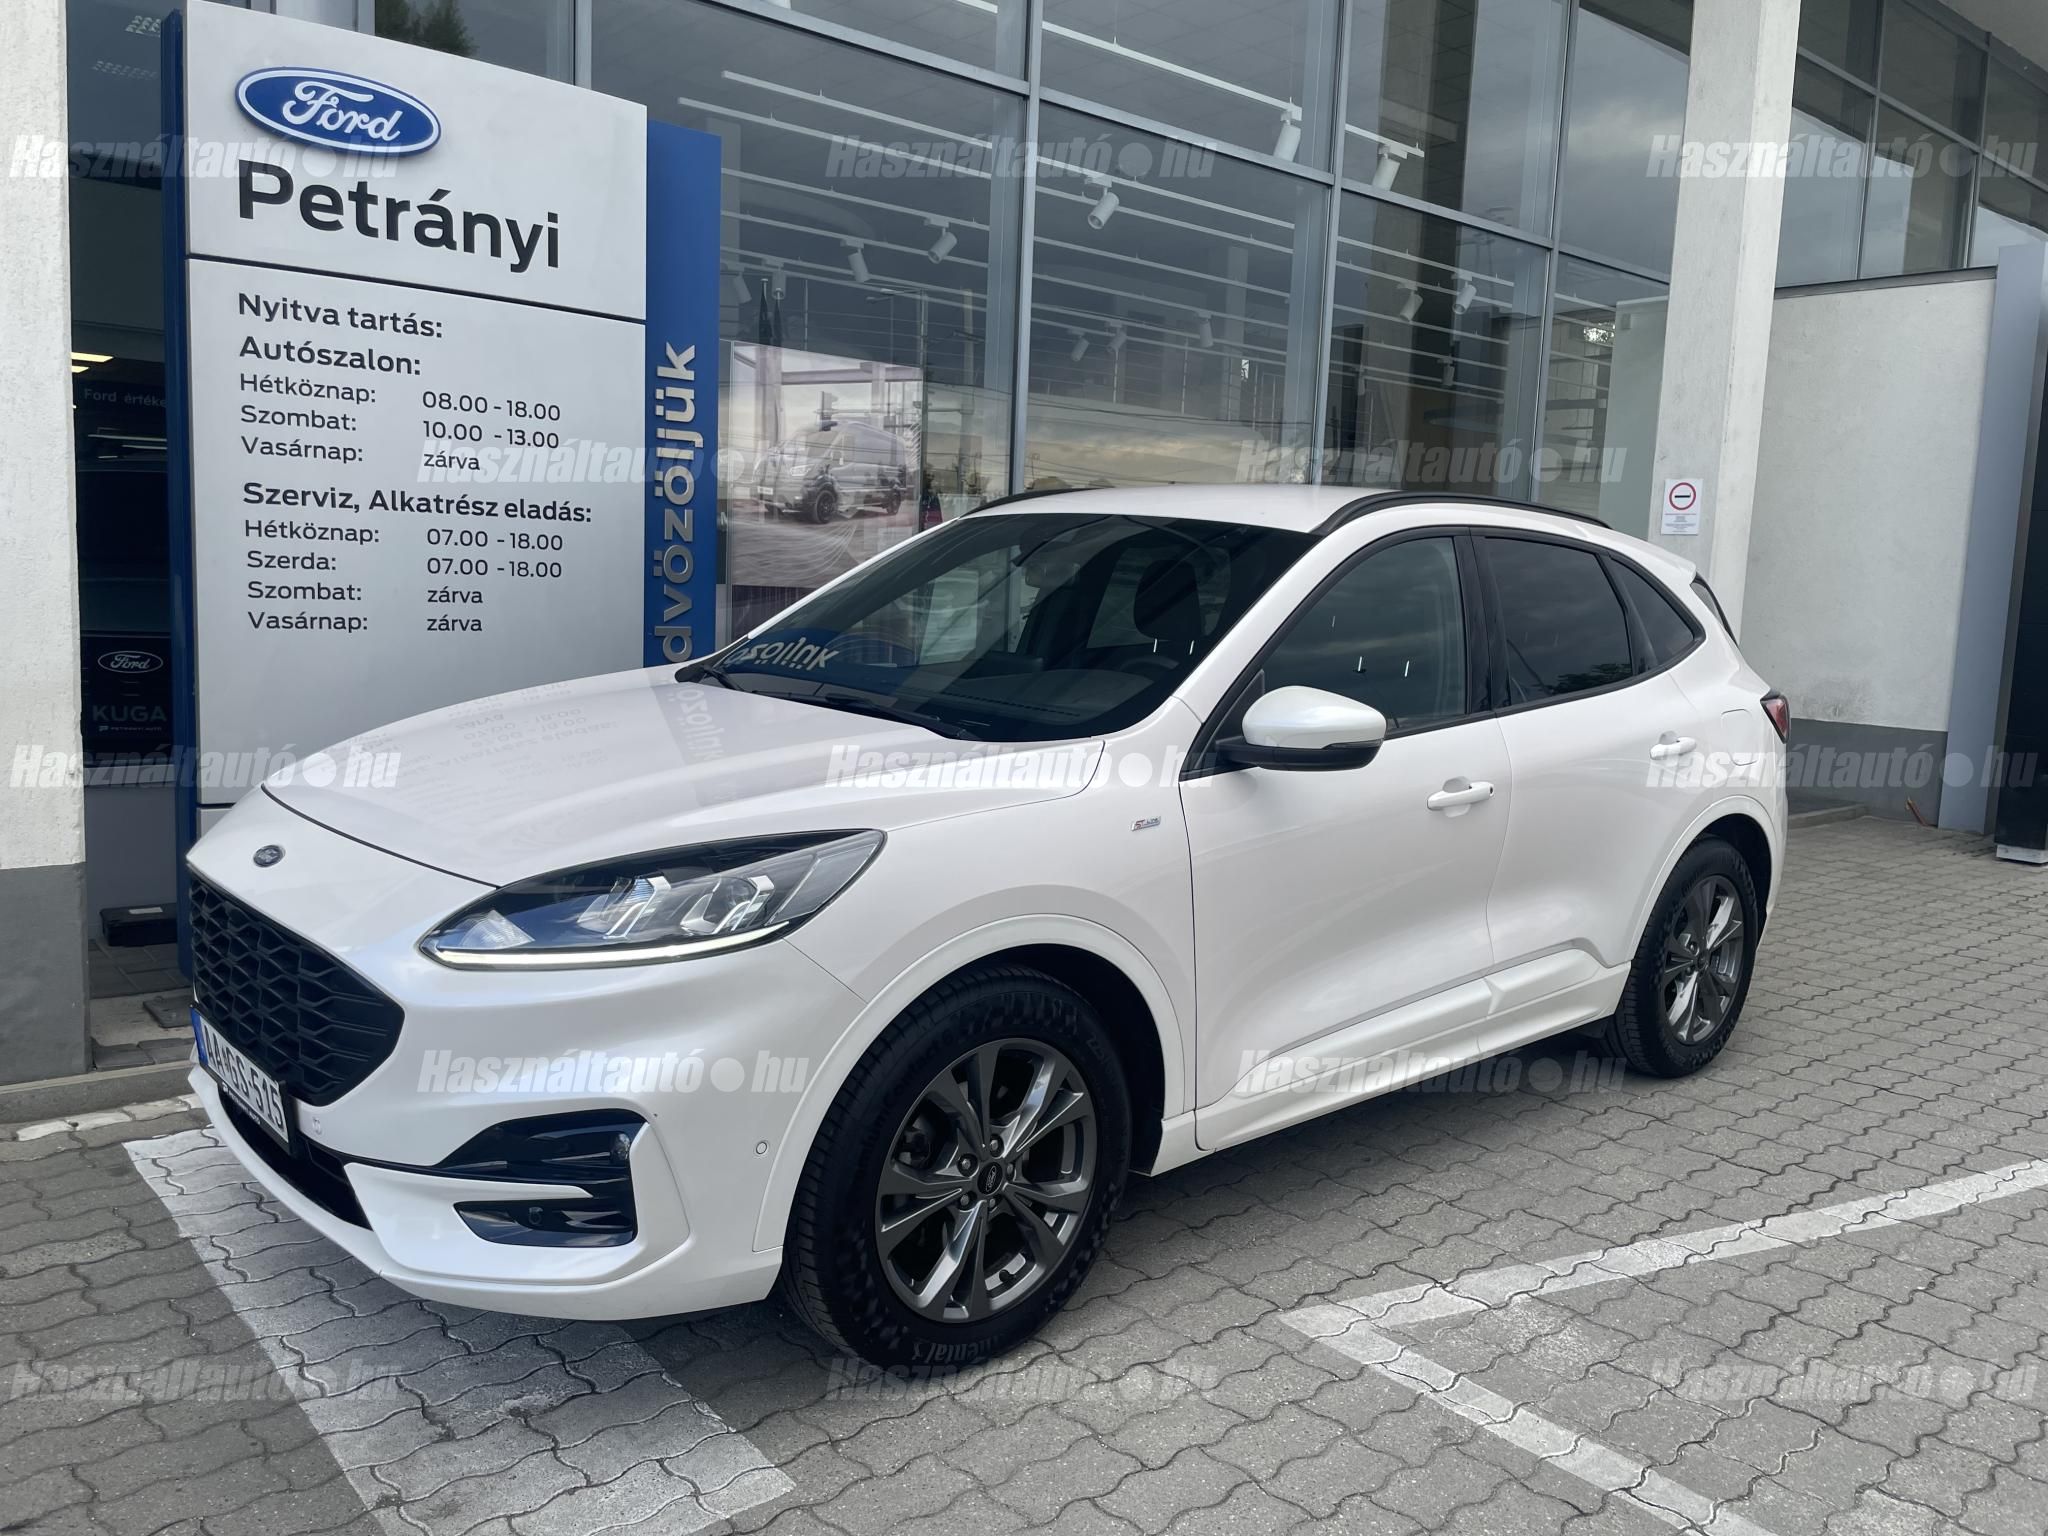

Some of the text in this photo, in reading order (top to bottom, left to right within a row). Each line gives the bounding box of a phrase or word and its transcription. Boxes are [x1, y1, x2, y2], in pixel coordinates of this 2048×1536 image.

[238, 159, 559, 273] Petrányi
[238, 293, 443, 338] Nyitva tartás:
[239, 335, 421, 375] Autószalon:
[83, 387, 117, 402] Ford
[240, 373, 376, 405] Hétköznap:
[423, 391, 488, 414] 08.00
[241, 404, 357, 432] Szombat:
[423, 420, 482, 442] 10.00
[241, 436, 363, 465] Vasárnap:
[424, 450, 481, 471] zárva
[243, 482, 592, 523] Szerviz, Alkatrész eladás:
[653, 341, 704, 663] dvözöljük
[246, 520, 380, 546] Hétköznap:
[427, 528, 489, 548] 07.00
[247, 550, 337, 571] Szerda:
[427, 557, 489, 576] 07.00
[248, 580, 362, 601] Szombat:
[427, 585, 484, 604] zárva
[248, 611, 368, 634] Vasárnap:
[427, 613, 483, 632] zárva
[110, 653, 151, 669] Ford
[92, 705, 167, 722] KUGA
